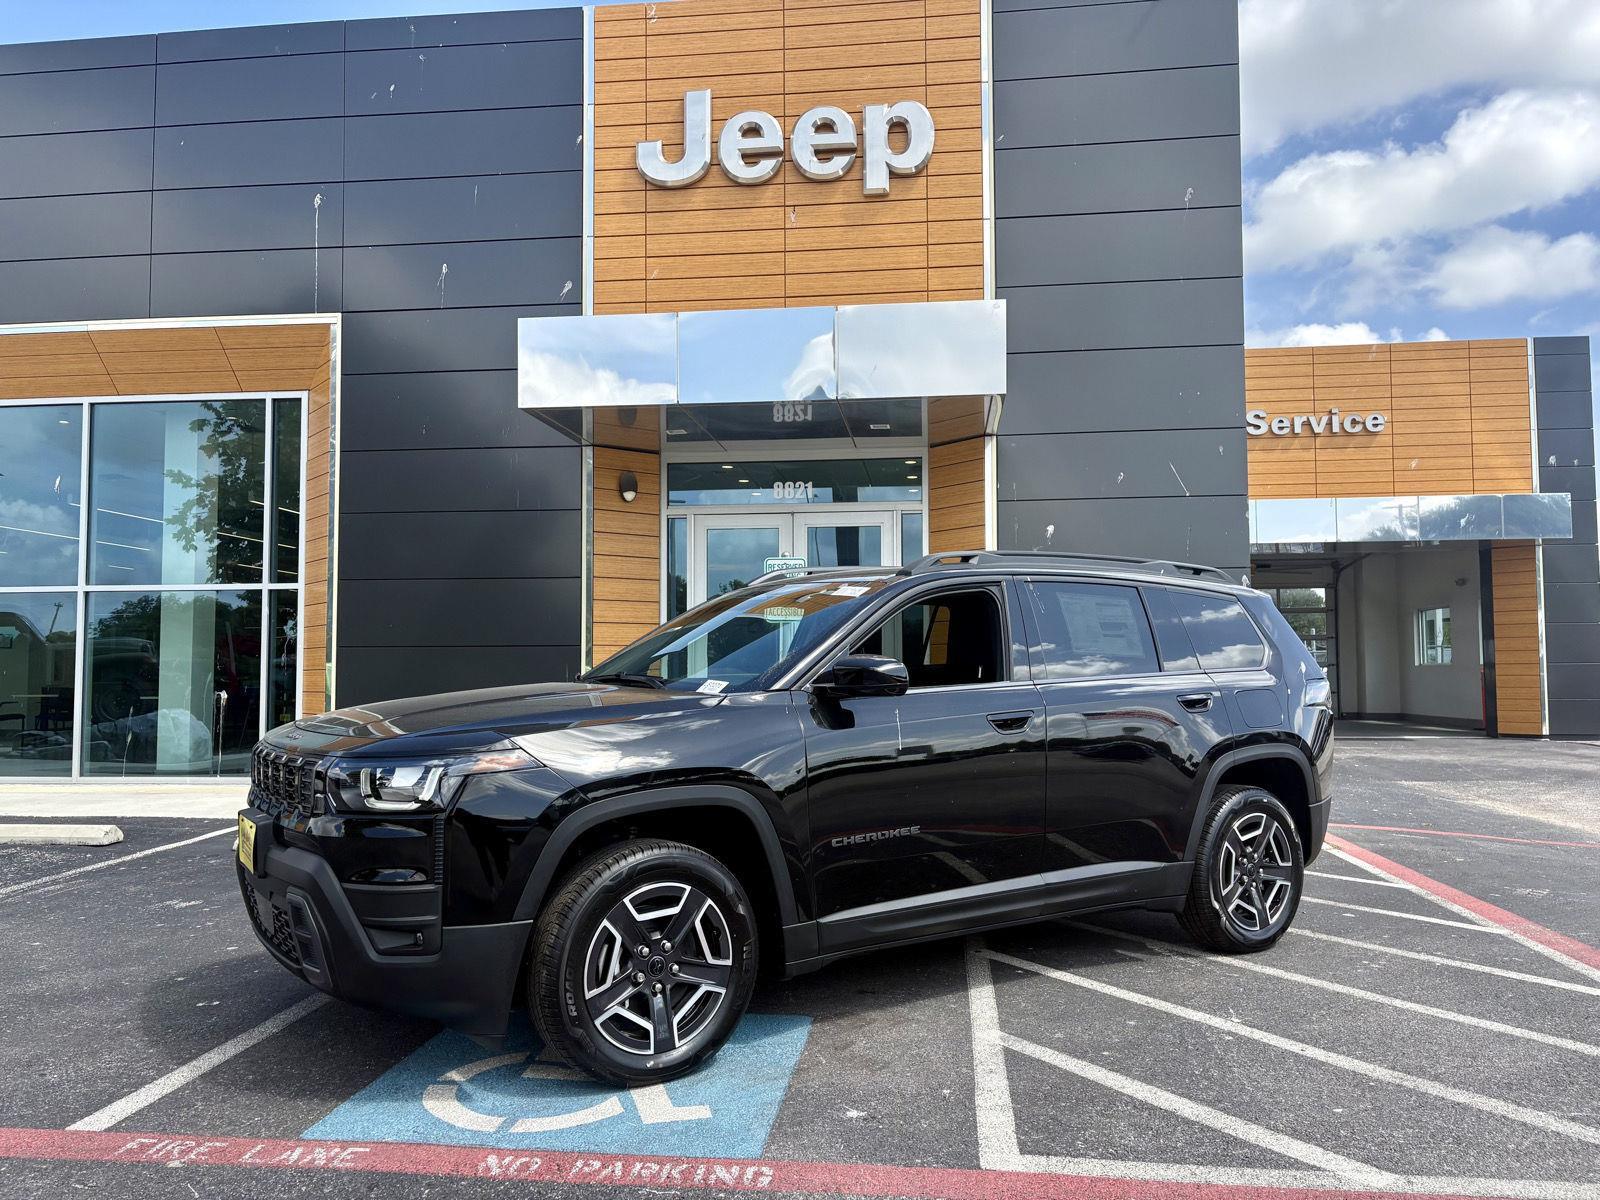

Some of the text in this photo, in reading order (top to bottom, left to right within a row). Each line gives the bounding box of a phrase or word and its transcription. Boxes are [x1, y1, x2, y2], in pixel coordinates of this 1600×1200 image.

[636, 88, 935, 196] Jeep
[1245, 407, 1386, 436] Service
[773, 481, 813, 499] 8821
[831, 825, 921, 848] CHEROKEE
[114, 1138, 370, 1169] FIRE LANE
[479, 1154, 774, 1187] NO PARKING
